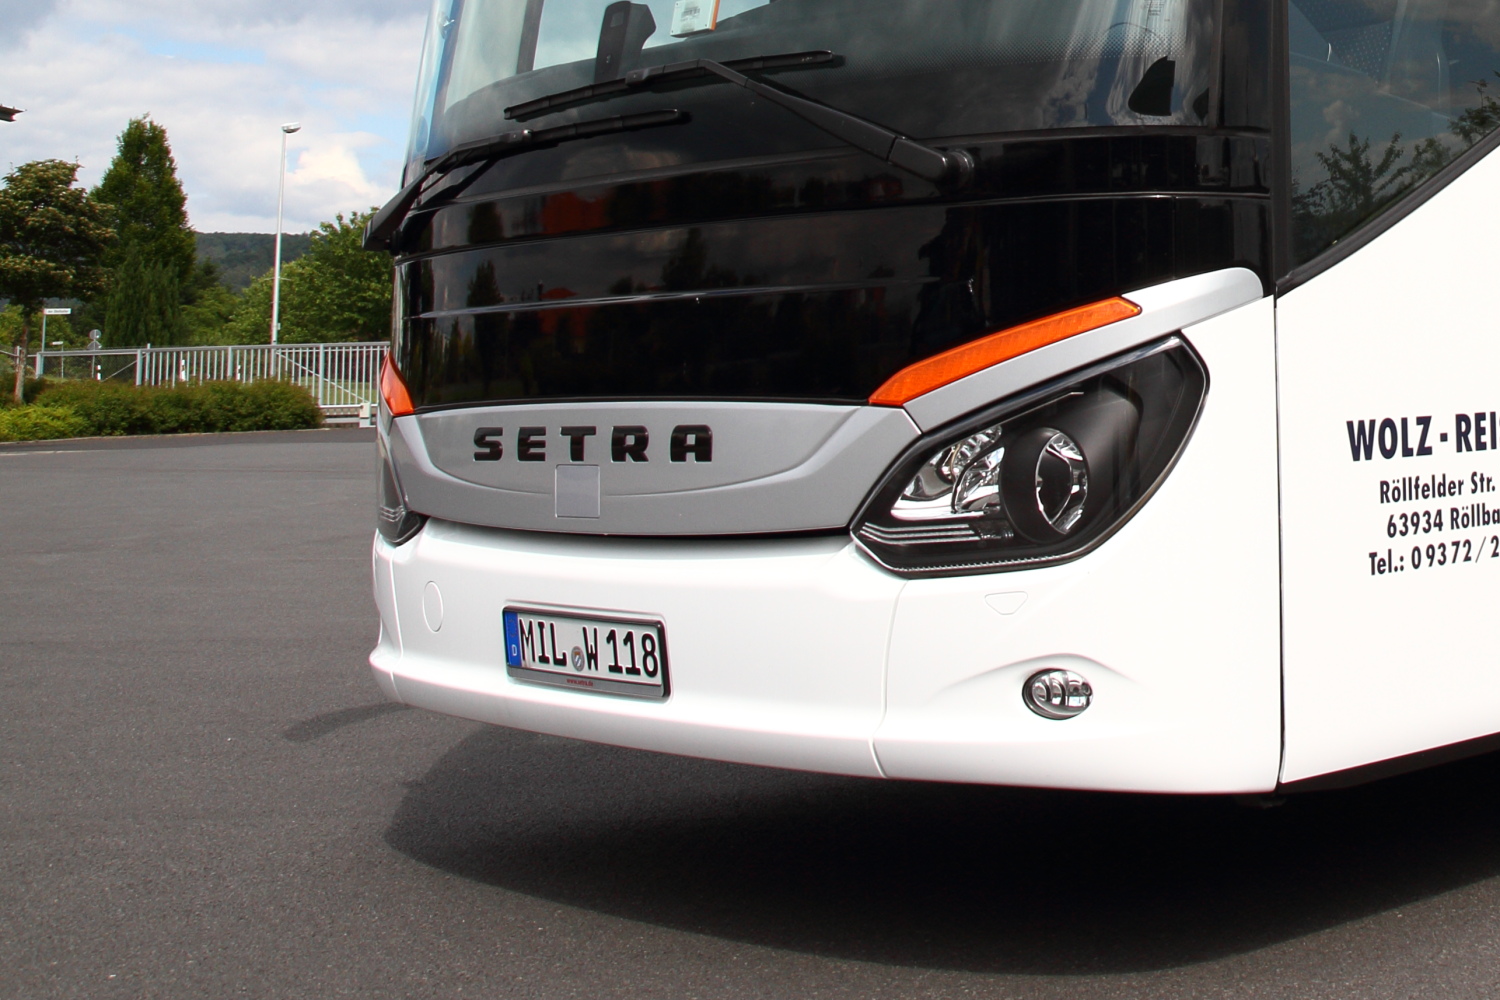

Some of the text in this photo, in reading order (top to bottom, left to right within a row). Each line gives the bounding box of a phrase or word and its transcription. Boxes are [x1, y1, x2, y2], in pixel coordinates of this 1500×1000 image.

[473, 424, 713, 462] SETRA
[1346, 415, 1433, 462] WOLZ
[1379, 473, 1464, 504] Röllfelder
[1470, 471, 1496, 495] Str.
[1387, 509, 1443, 538] 63934
[1369, 548, 1404, 576] Tel.:
[511, 644, 518, 656] D
[519, 618, 659, 678] MIL W 118
